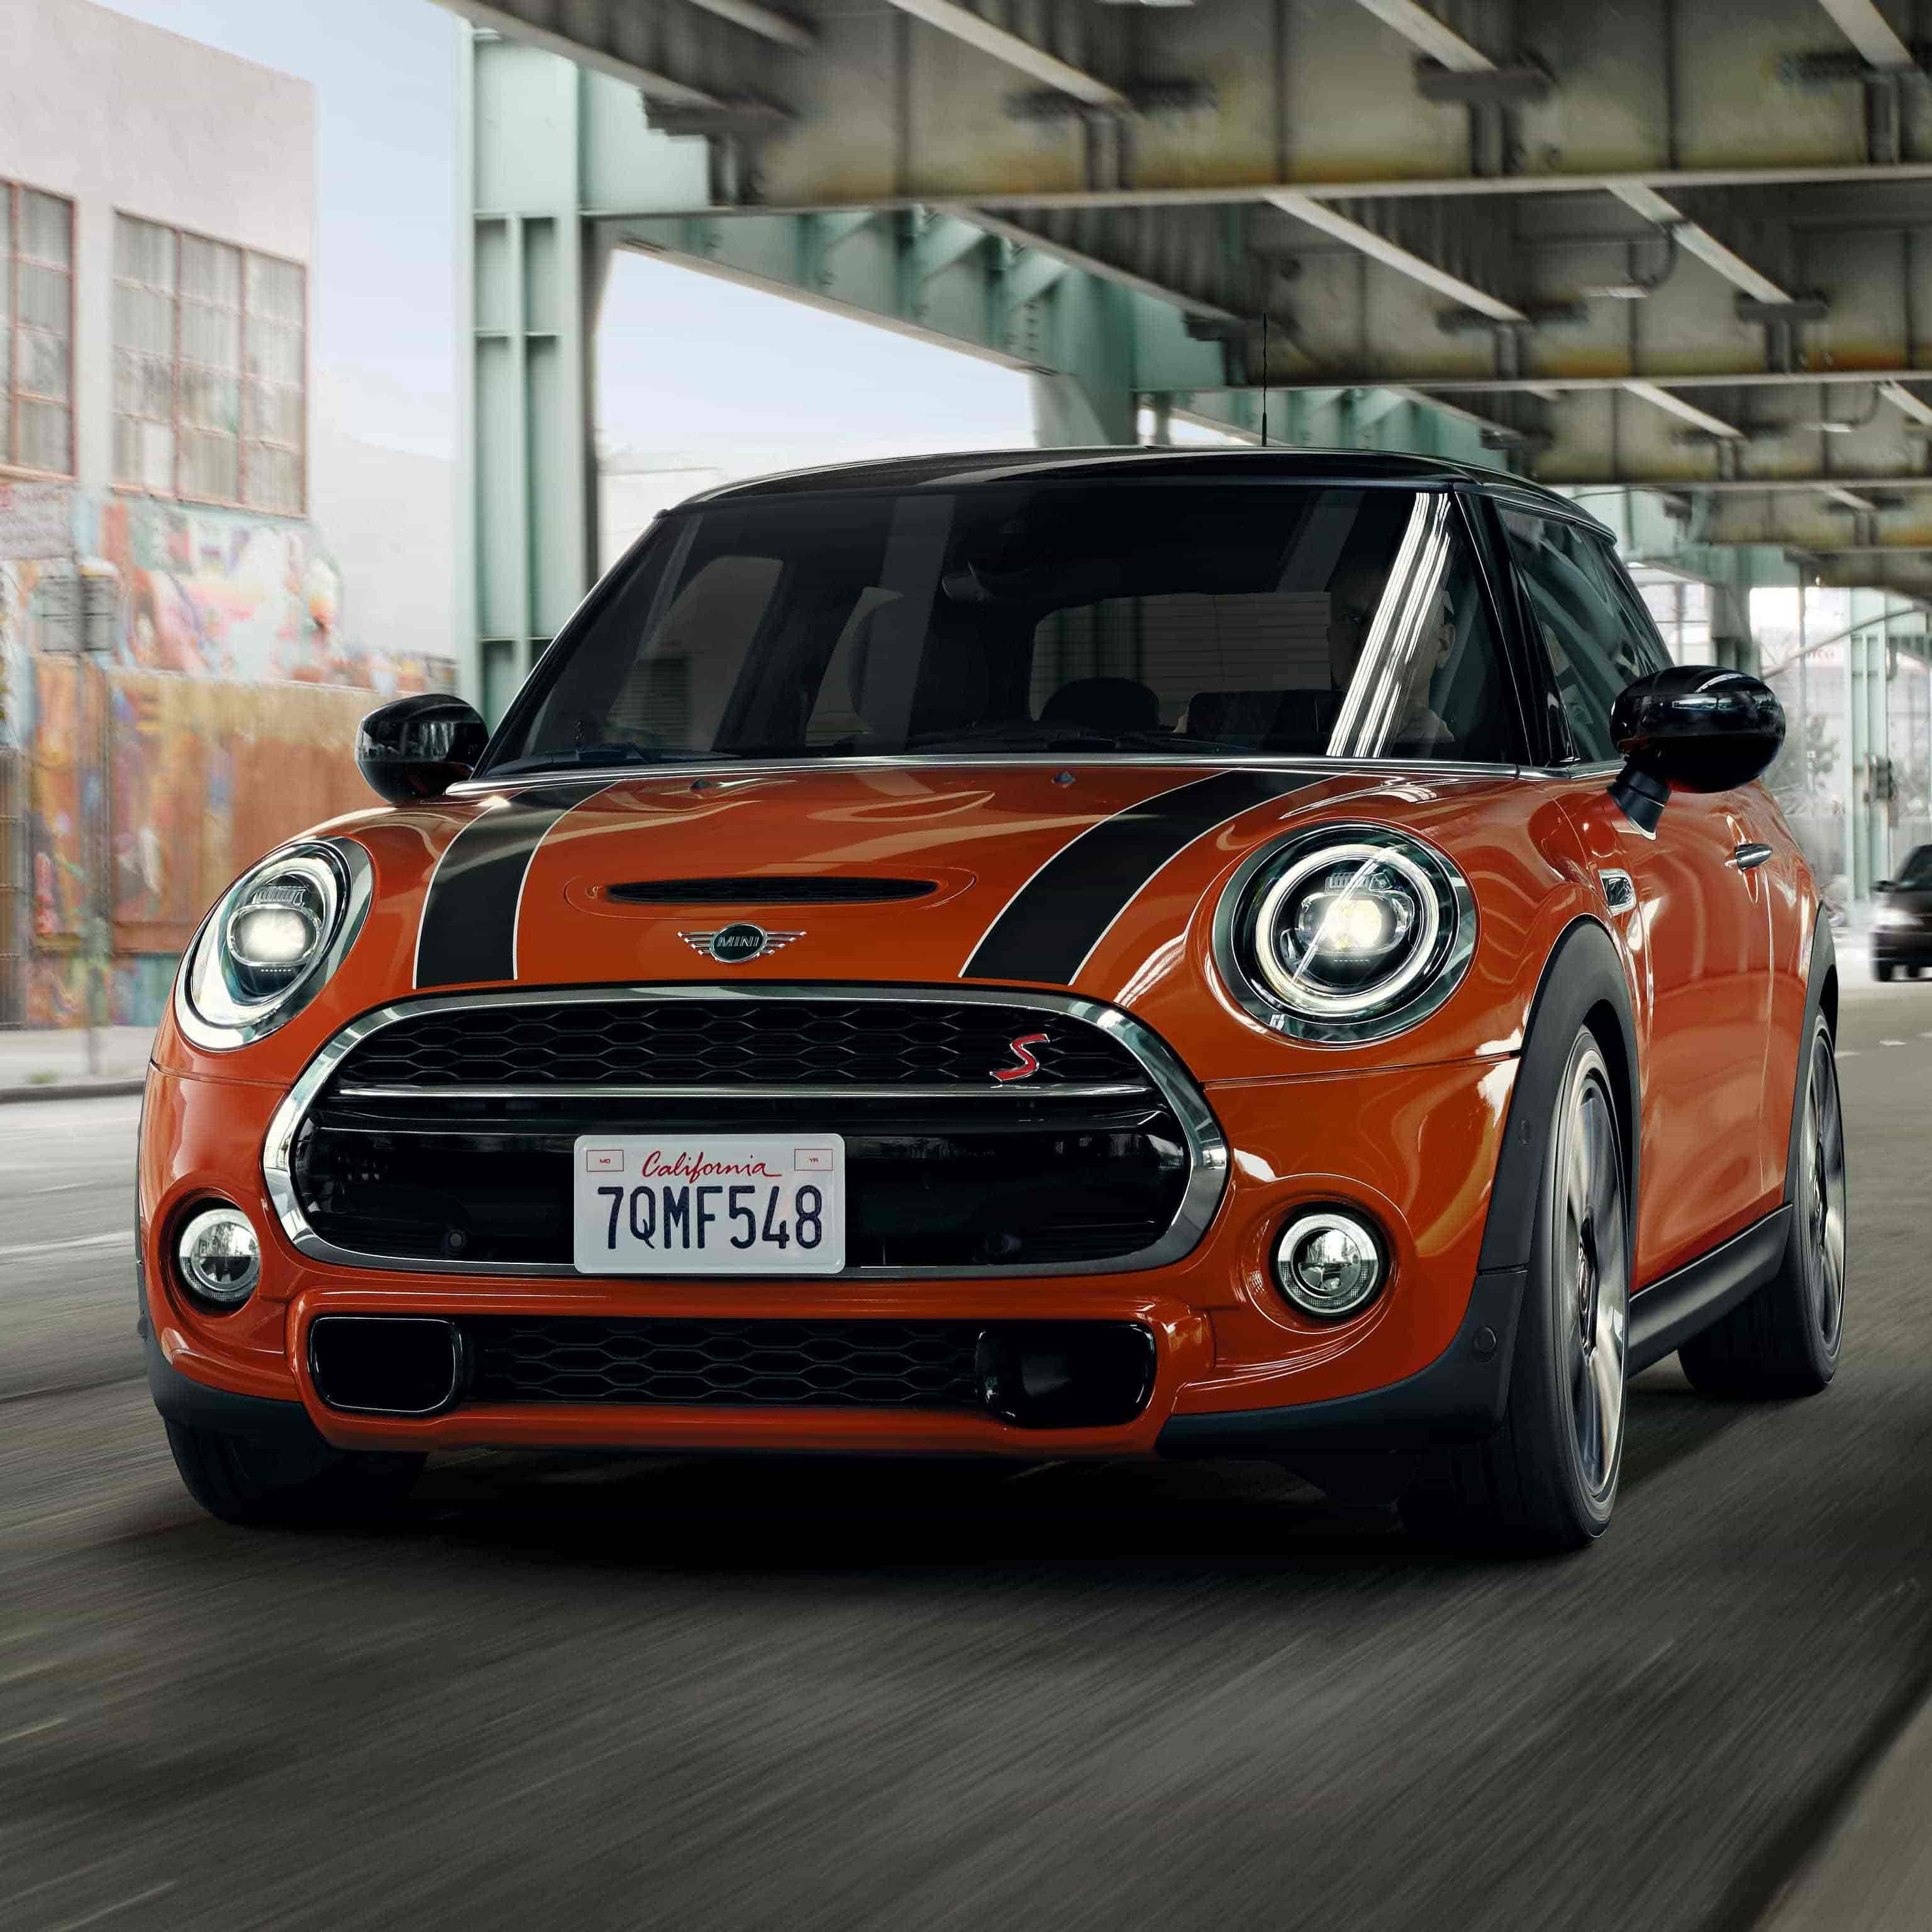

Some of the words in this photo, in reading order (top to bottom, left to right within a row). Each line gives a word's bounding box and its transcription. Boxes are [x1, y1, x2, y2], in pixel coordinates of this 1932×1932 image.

[717, 936, 760, 947] MINI
[989, 1033, 1050, 1082] S
[642, 1150, 782, 1184] California
[597, 1185, 822, 1250] 7QMF548
